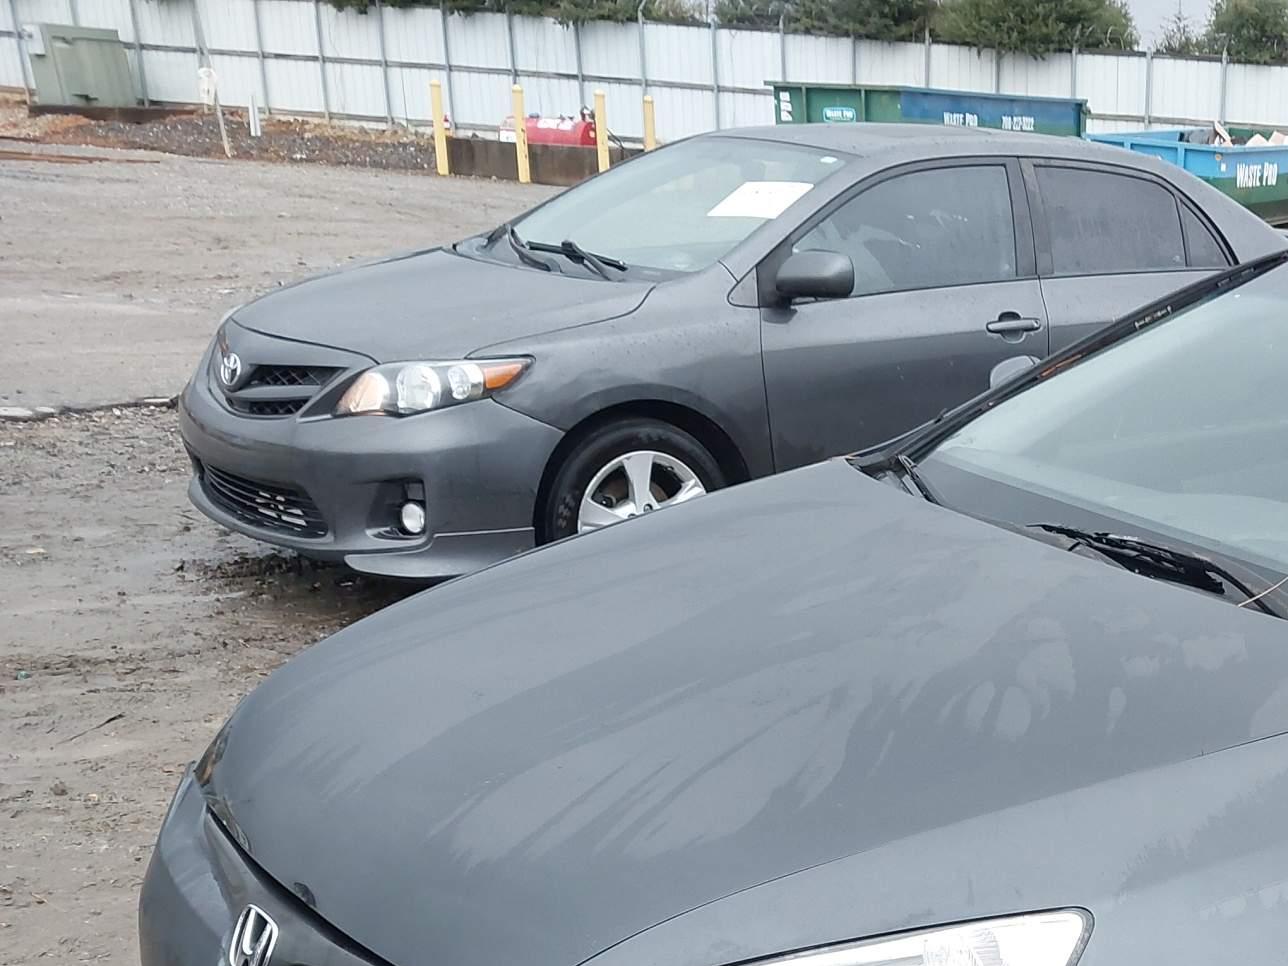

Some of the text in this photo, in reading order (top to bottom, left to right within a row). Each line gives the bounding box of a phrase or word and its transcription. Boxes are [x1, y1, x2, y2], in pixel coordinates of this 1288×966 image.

[965, 112, 979, 128] PRO
[1236, 161, 1278, 189] WASTE PRO
